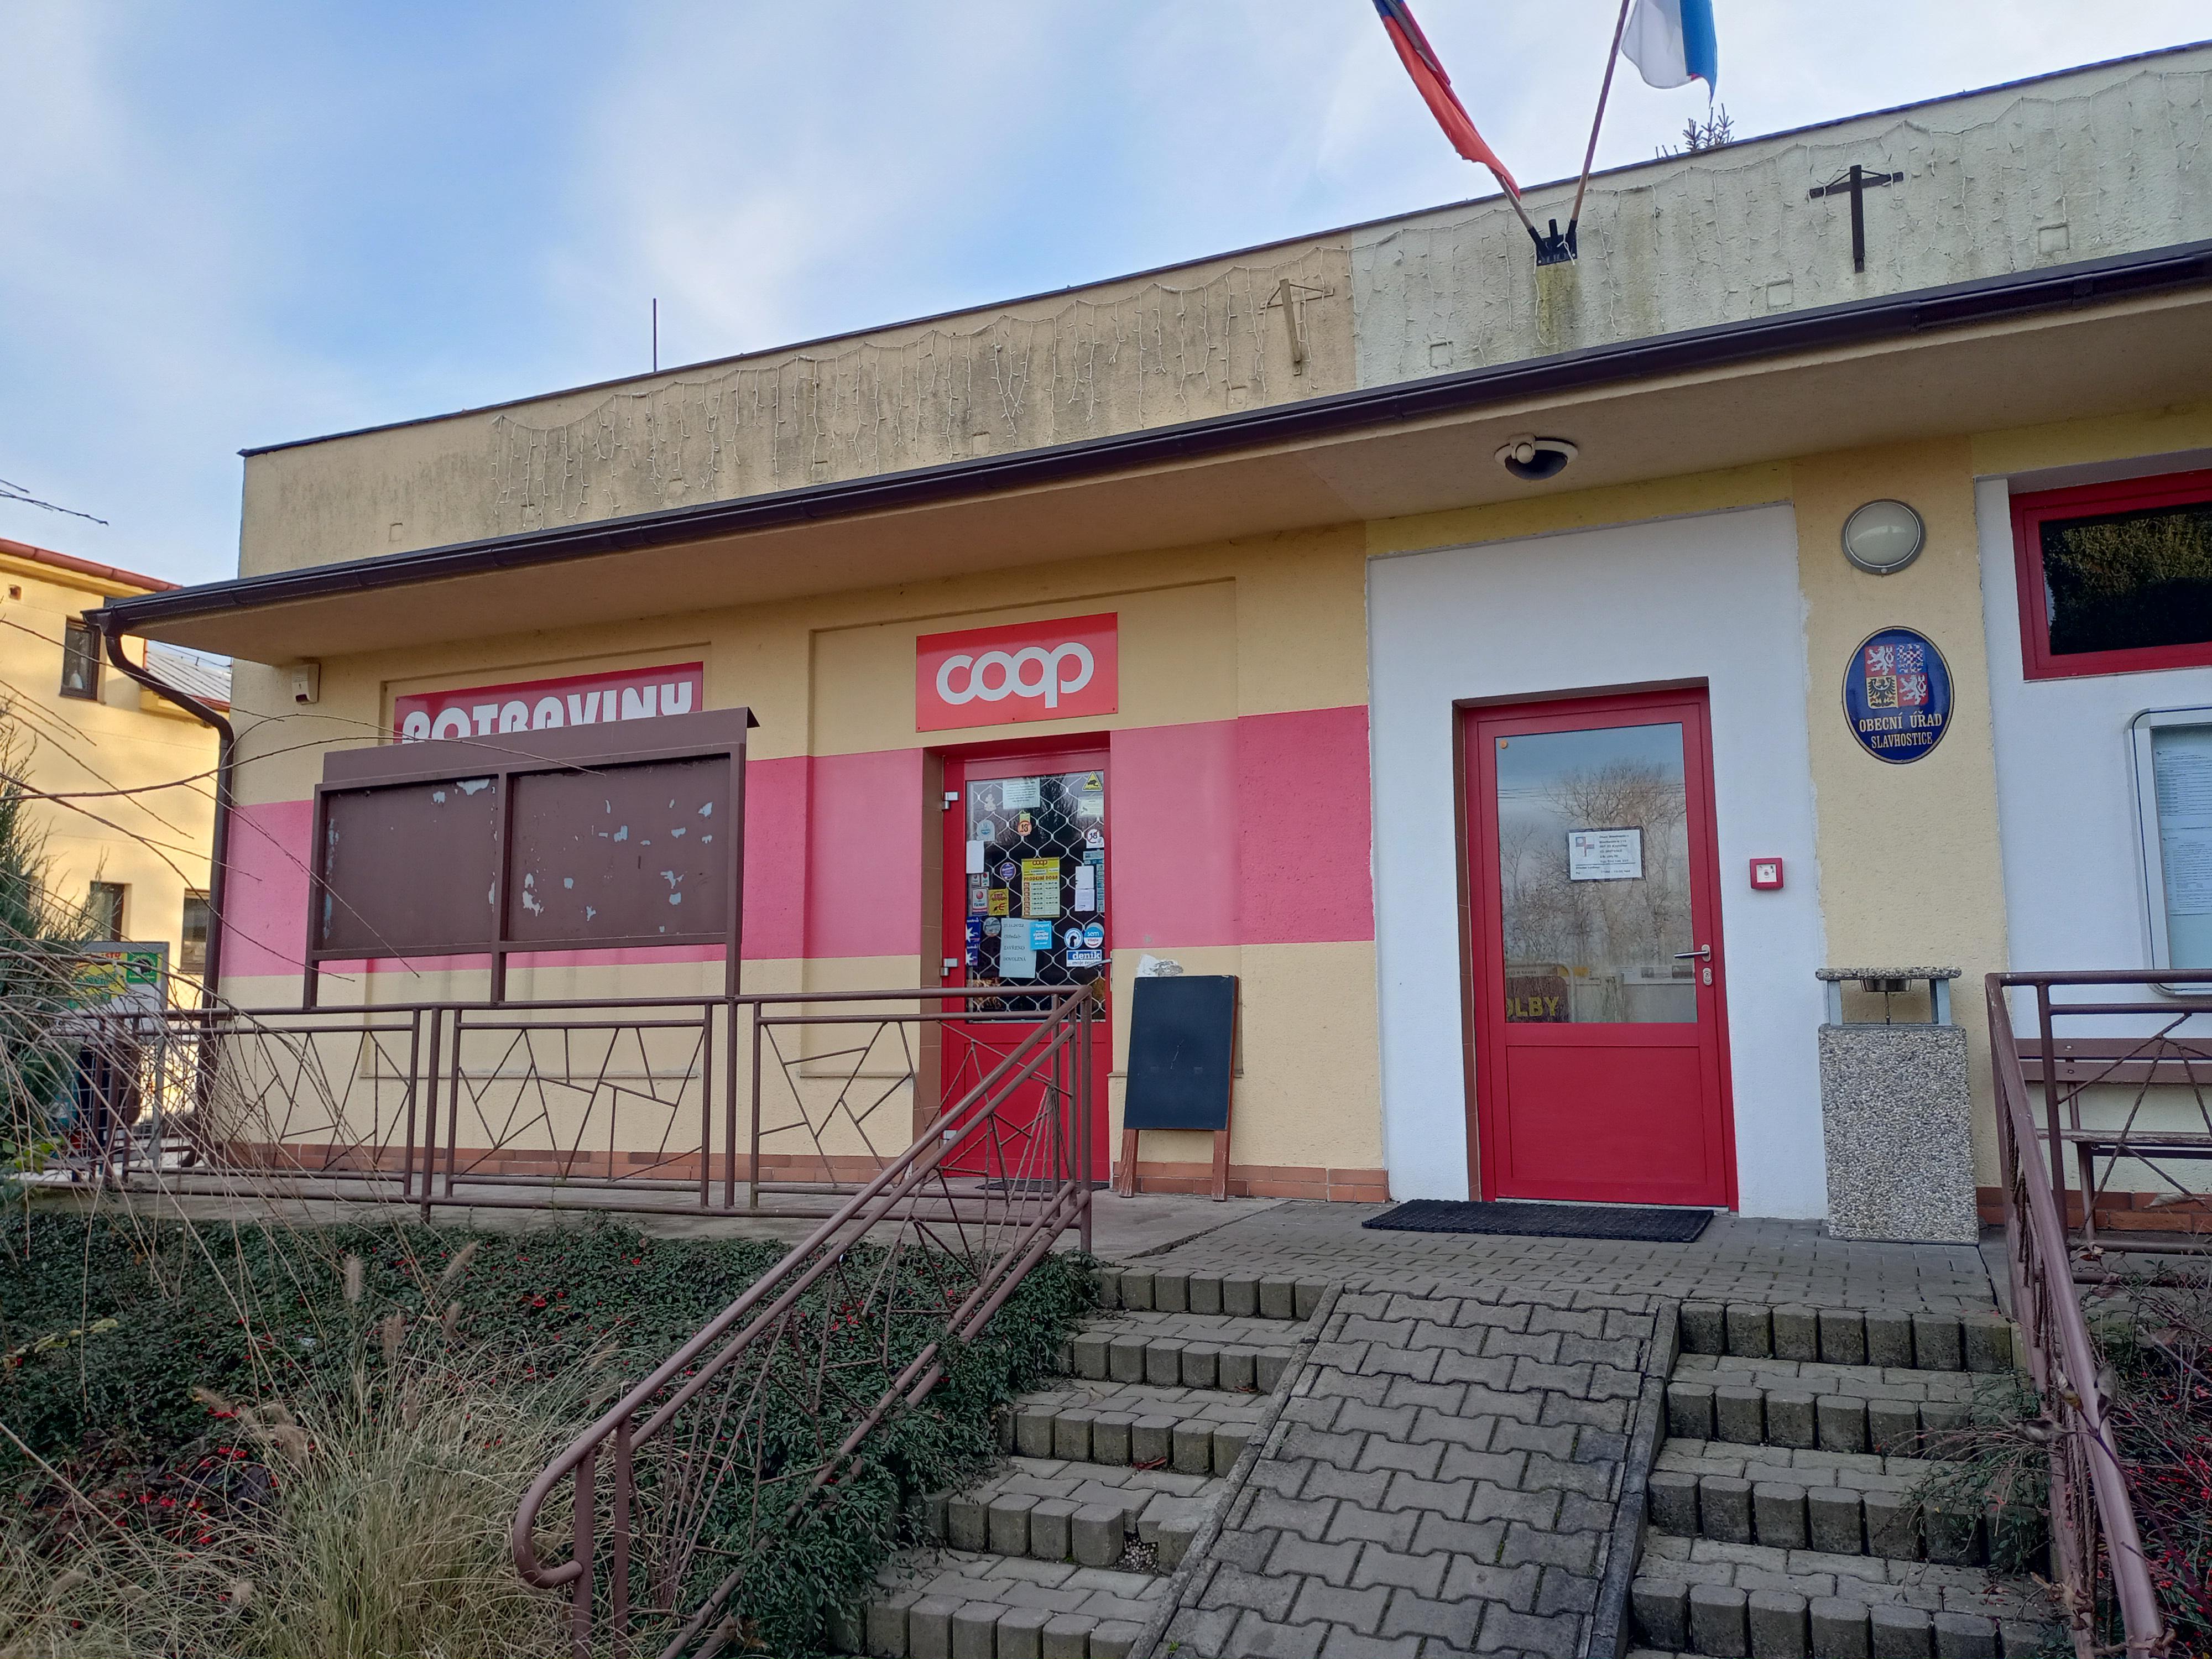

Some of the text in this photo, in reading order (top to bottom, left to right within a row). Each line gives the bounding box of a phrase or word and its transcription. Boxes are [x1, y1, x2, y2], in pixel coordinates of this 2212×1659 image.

[936, 642, 1094, 708] coop
[1859, 710, 1942, 733] OBECNÍ ÚŘAD
[1871, 732, 1933, 749] SLAVHOSTICE
